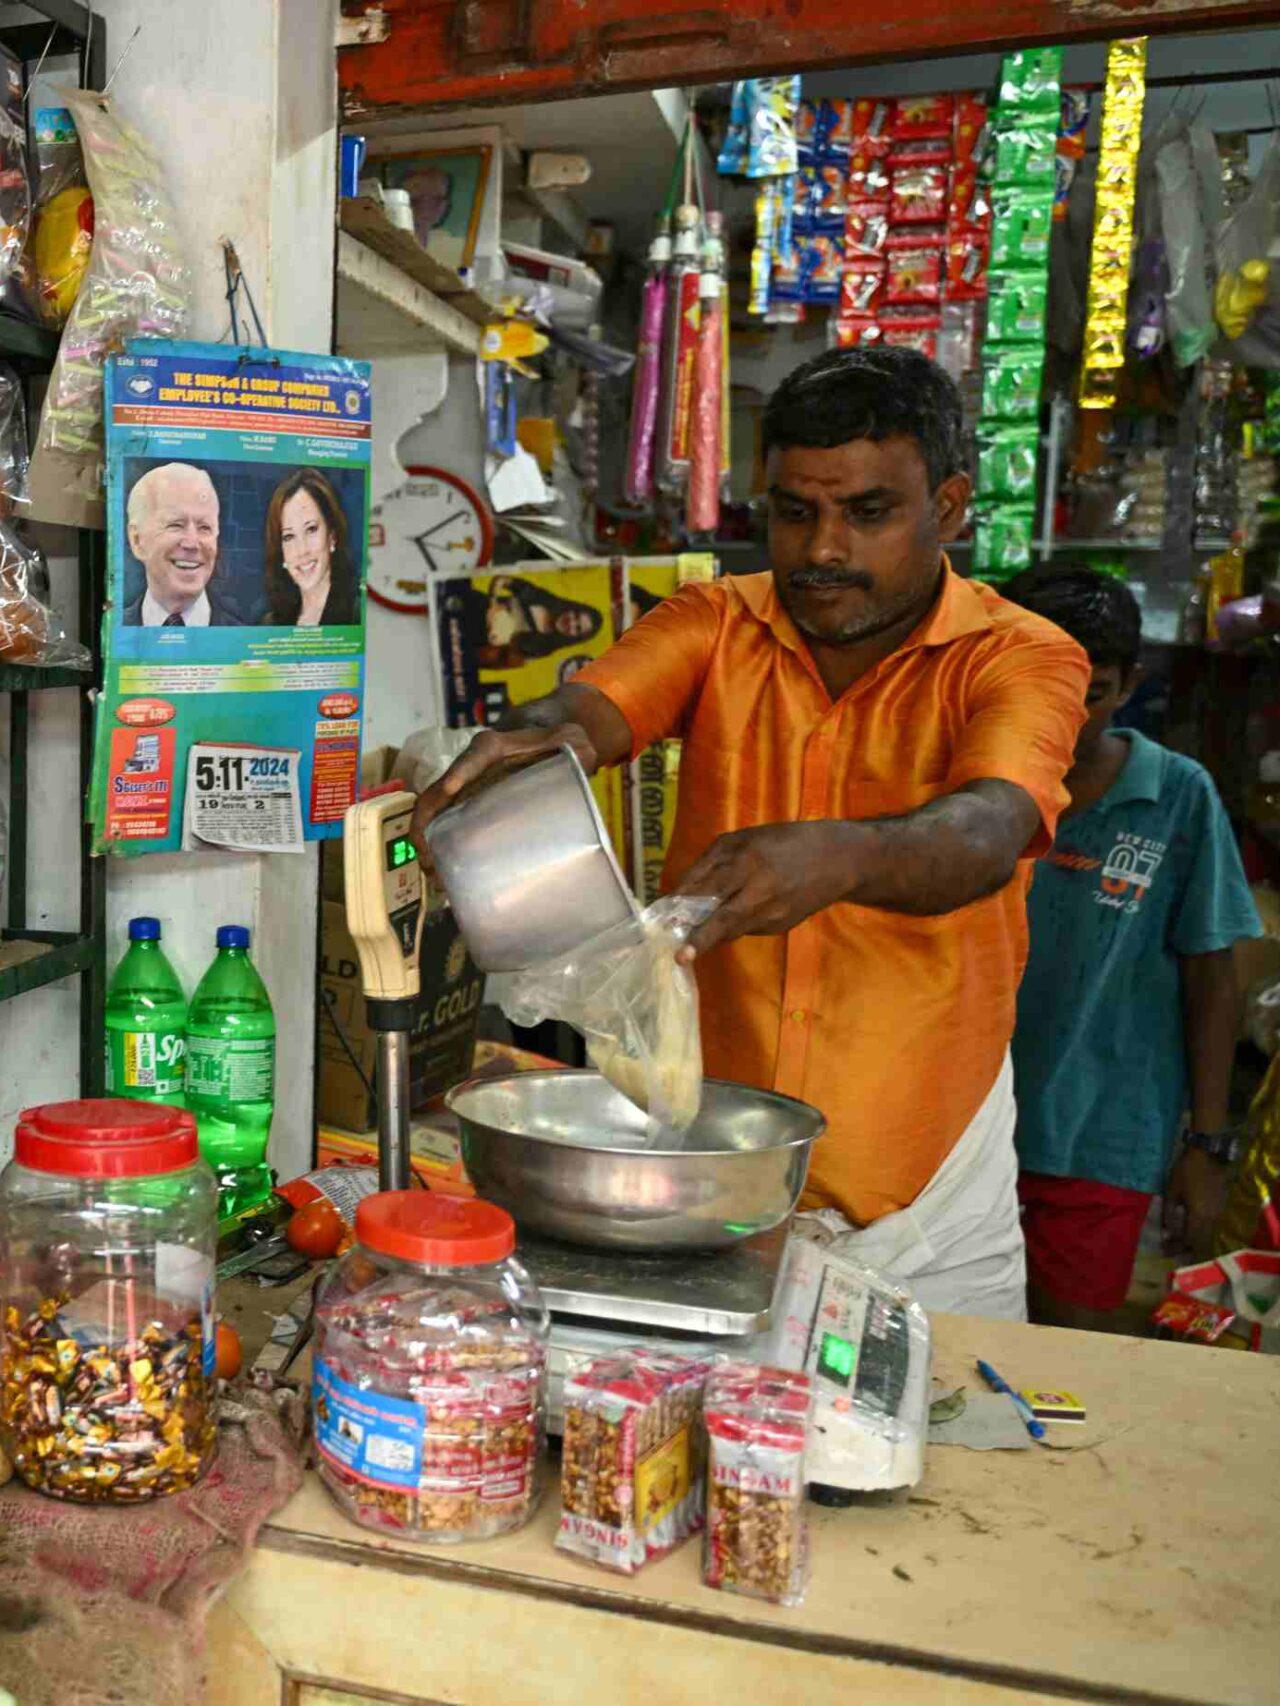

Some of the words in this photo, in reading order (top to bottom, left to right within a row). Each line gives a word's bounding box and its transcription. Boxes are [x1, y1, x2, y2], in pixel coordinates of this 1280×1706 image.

[173, 371, 192, 386] THE
[250, 758, 290, 776] 2024
[199, 799, 219, 809] 19
[254, 800, 265, 810] 2
[319, 956, 357, 978] LD
[433, 980, 481, 1026] GOLD
